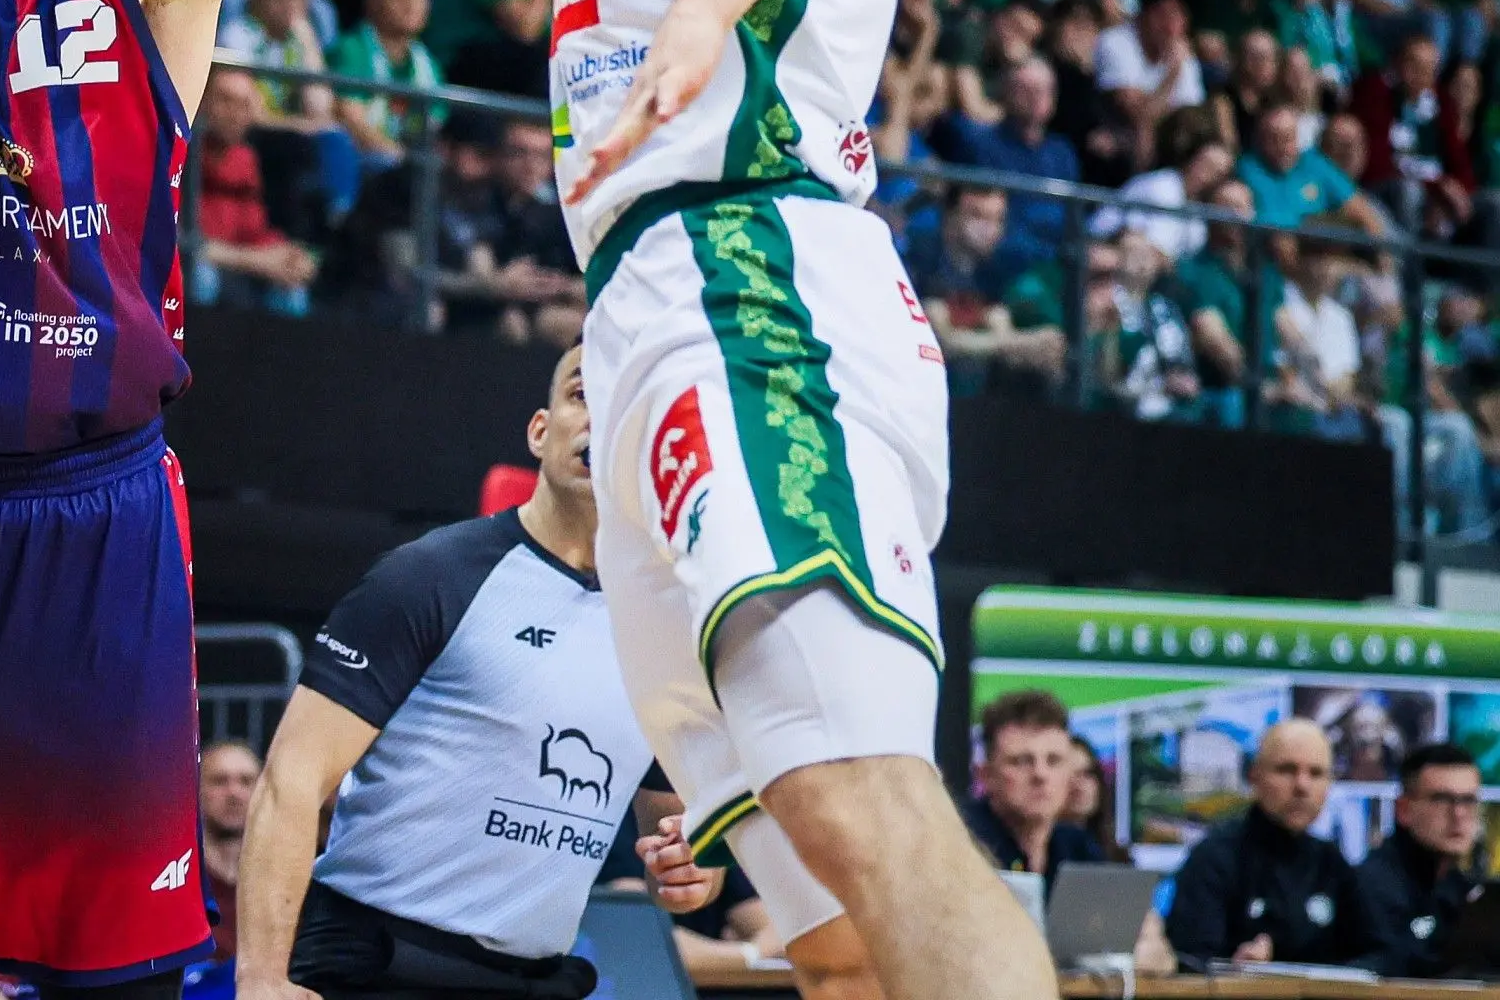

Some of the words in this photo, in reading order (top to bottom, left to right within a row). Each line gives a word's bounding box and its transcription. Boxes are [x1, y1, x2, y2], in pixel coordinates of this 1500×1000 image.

[9, 0, 118, 94] 12
[14, 309, 57, 324] floating
[59, 313, 97, 326] garden
[39, 326, 99, 346] 2050
[56, 346, 93, 359] project
[515, 626, 556, 648] 4F
[485, 809, 553, 848] Bank
[557, 825, 609, 860] Peka
[151, 848, 192, 891] 4F
